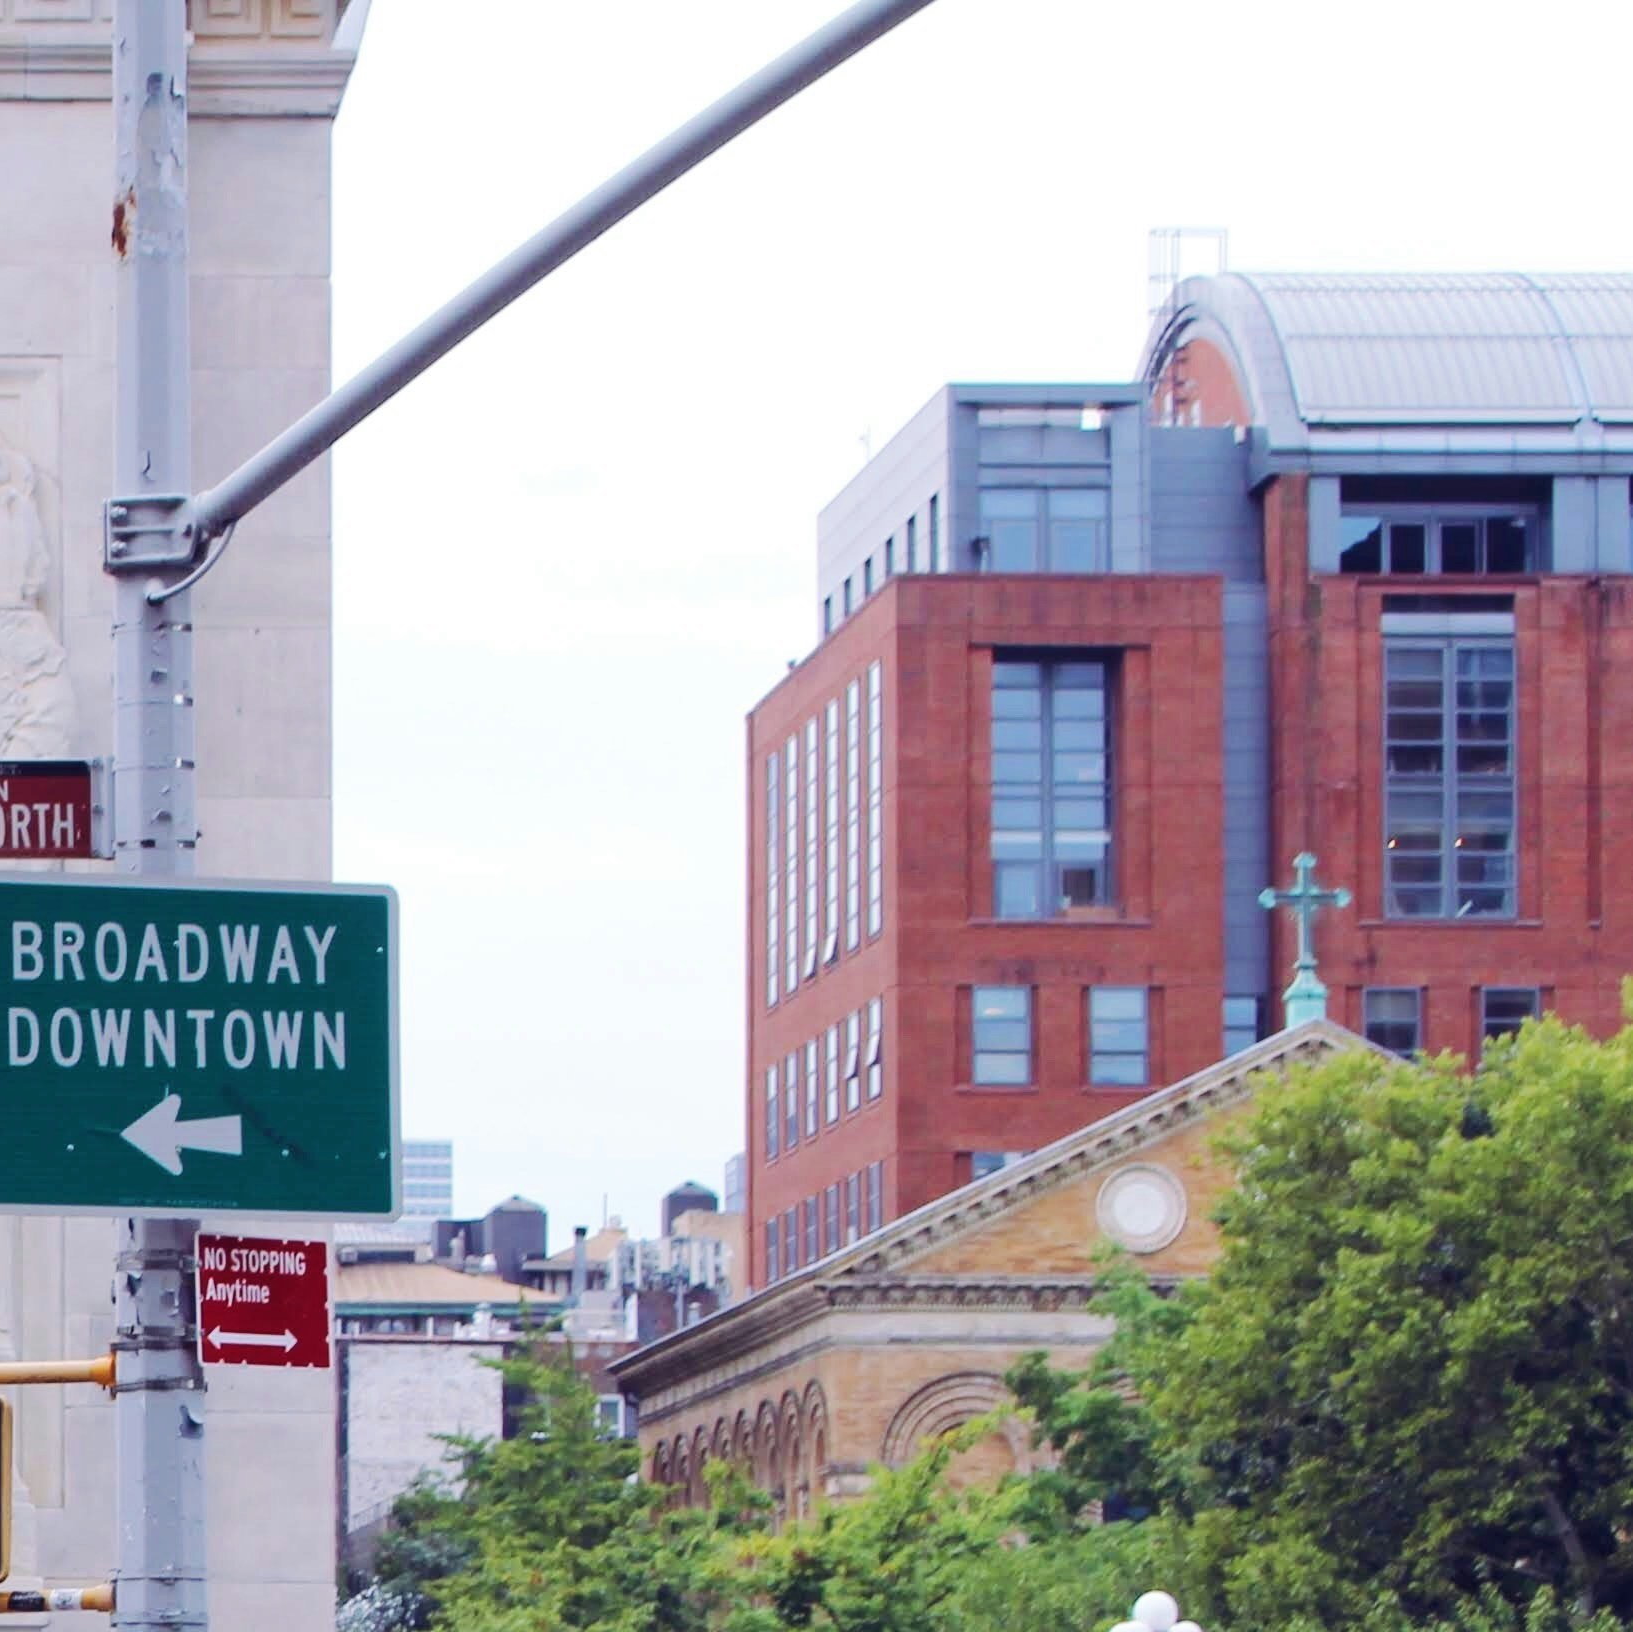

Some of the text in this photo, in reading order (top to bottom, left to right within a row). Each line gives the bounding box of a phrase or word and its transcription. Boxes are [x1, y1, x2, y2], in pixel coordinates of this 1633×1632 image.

[12, 920, 336, 984] BROADWAY
[8, 1007, 346, 1069] DOWNTOWN
[204, 1247, 306, 1275] NO STOPPING
[206, 1277, 270, 1307] Anytime
